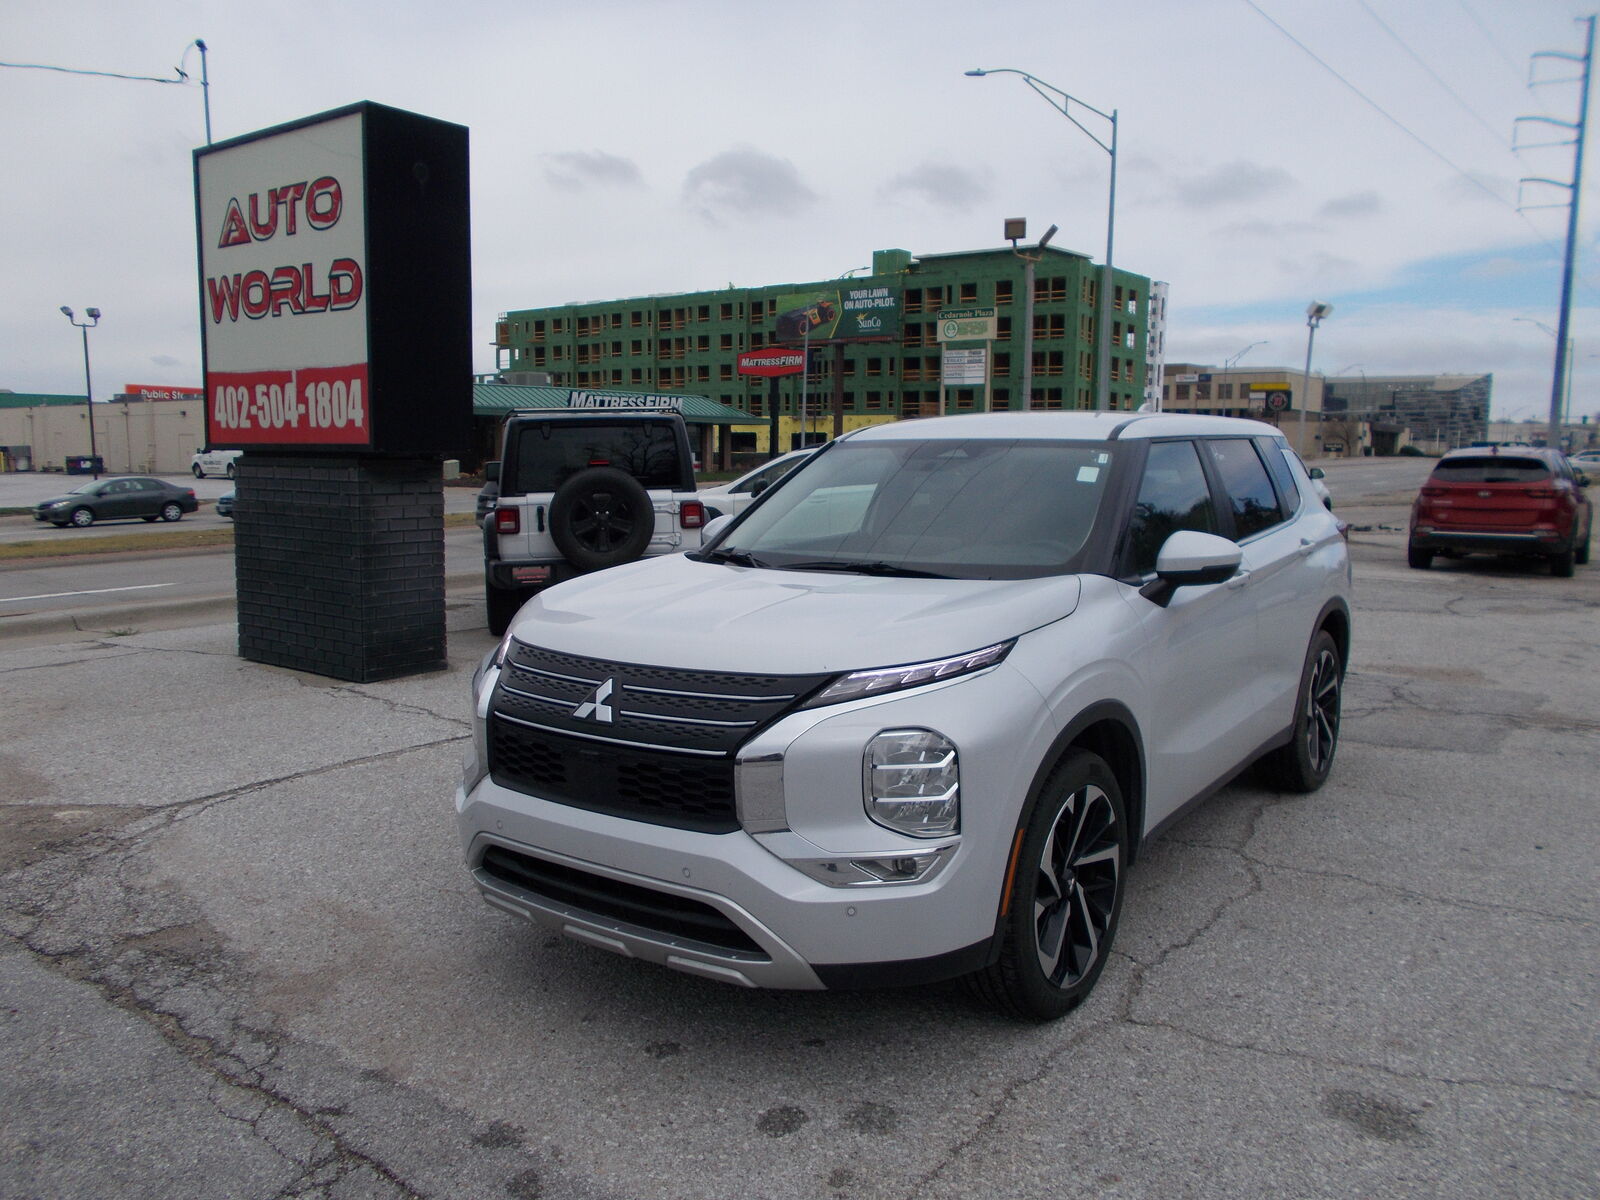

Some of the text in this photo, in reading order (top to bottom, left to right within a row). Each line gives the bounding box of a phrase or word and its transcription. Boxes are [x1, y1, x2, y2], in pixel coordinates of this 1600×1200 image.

[217, 176, 343, 249] AUTO
[207, 257, 363, 324] WORLD
[850, 288, 889, 299] YOUR LAWN
[844, 297, 895, 310] ON AUTO-PILOT.
[975, 309, 993, 317] Plaza
[858, 316, 881, 328] SunCo
[141, 389, 170, 399] Public
[214, 377, 364, 429] 402-504-1804
